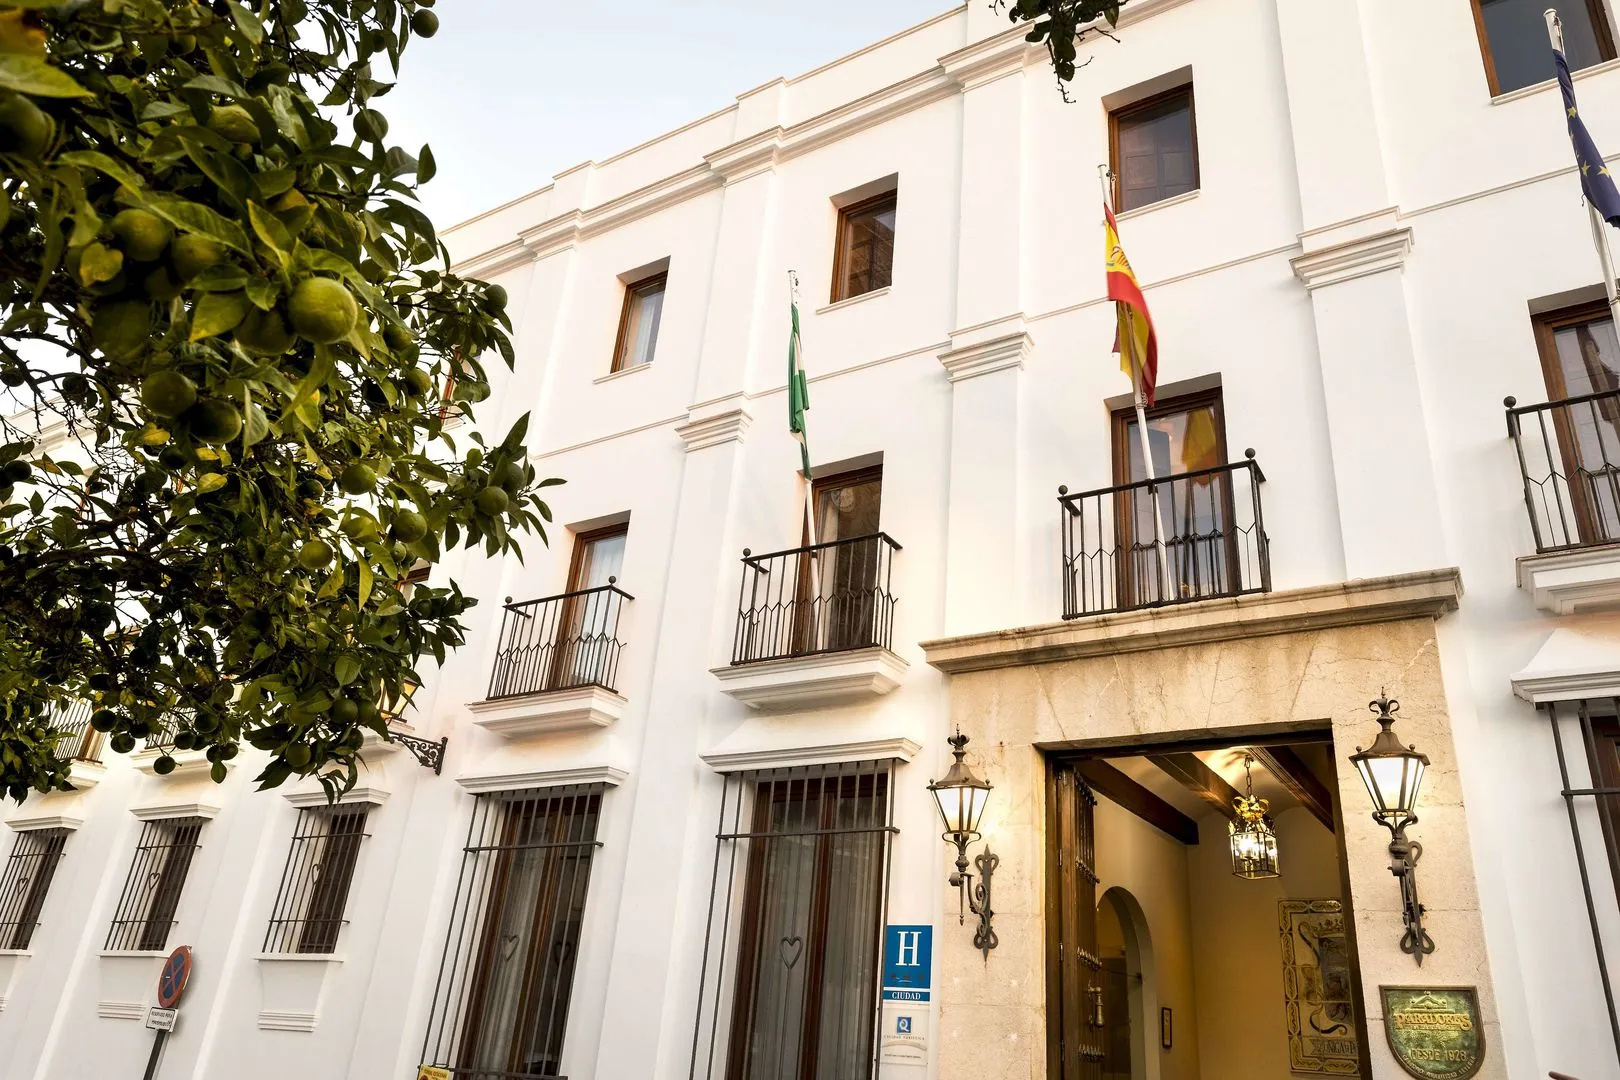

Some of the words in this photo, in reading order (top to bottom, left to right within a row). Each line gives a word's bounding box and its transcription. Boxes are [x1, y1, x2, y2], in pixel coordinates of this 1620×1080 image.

[896, 931, 922, 966] H
[892, 992, 921, 1000] CIUDAD
[1394, 1012, 1473, 1031] PARADORES
[1410, 1048, 1441, 1061] DESDE
